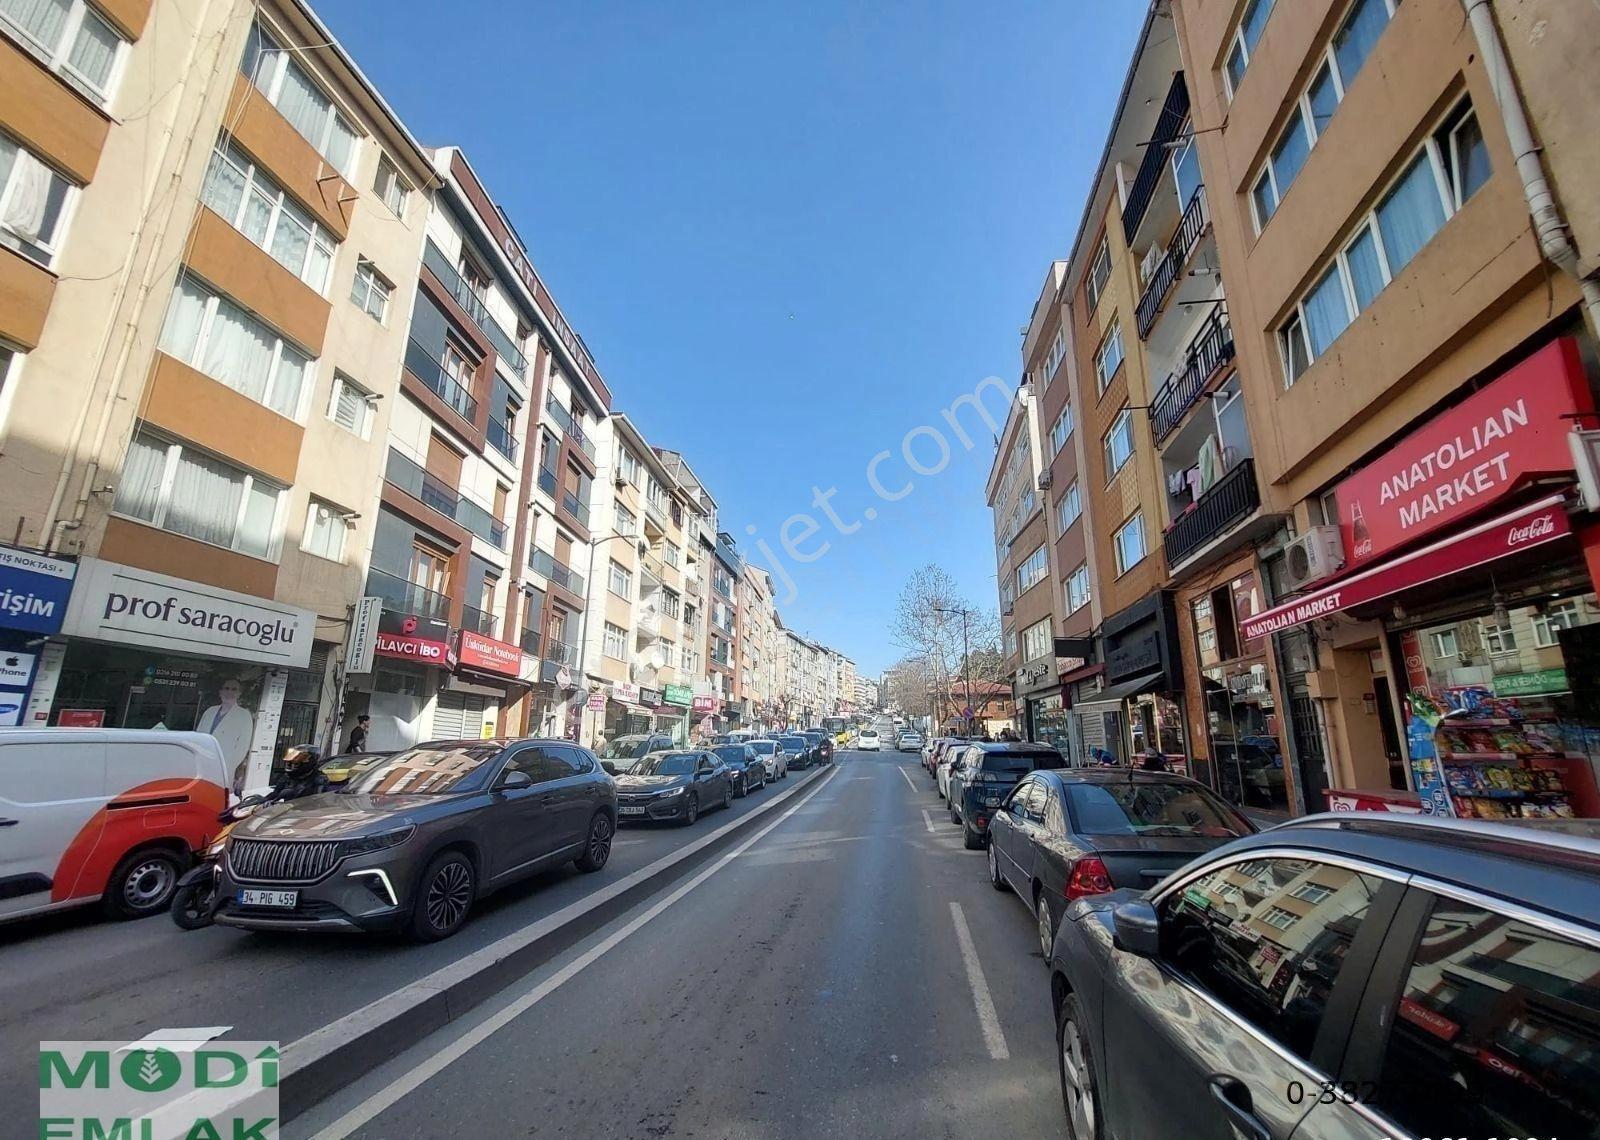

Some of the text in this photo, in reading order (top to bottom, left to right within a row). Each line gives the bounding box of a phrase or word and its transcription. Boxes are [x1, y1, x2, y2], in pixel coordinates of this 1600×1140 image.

[1380, 399, 1530, 506] ANATOLIAN
[1399, 452, 1511, 529] MARKET
[14, 556, 57, 572] NOKTASI
[103, 592, 294, 646] prof saracoglu
[1246, 592, 1342, 638] ANATOLIAN MARKET
[377, 635, 440, 657] İLAVCI İBO
[243, 891, 295, 906] 34 PIG 459
